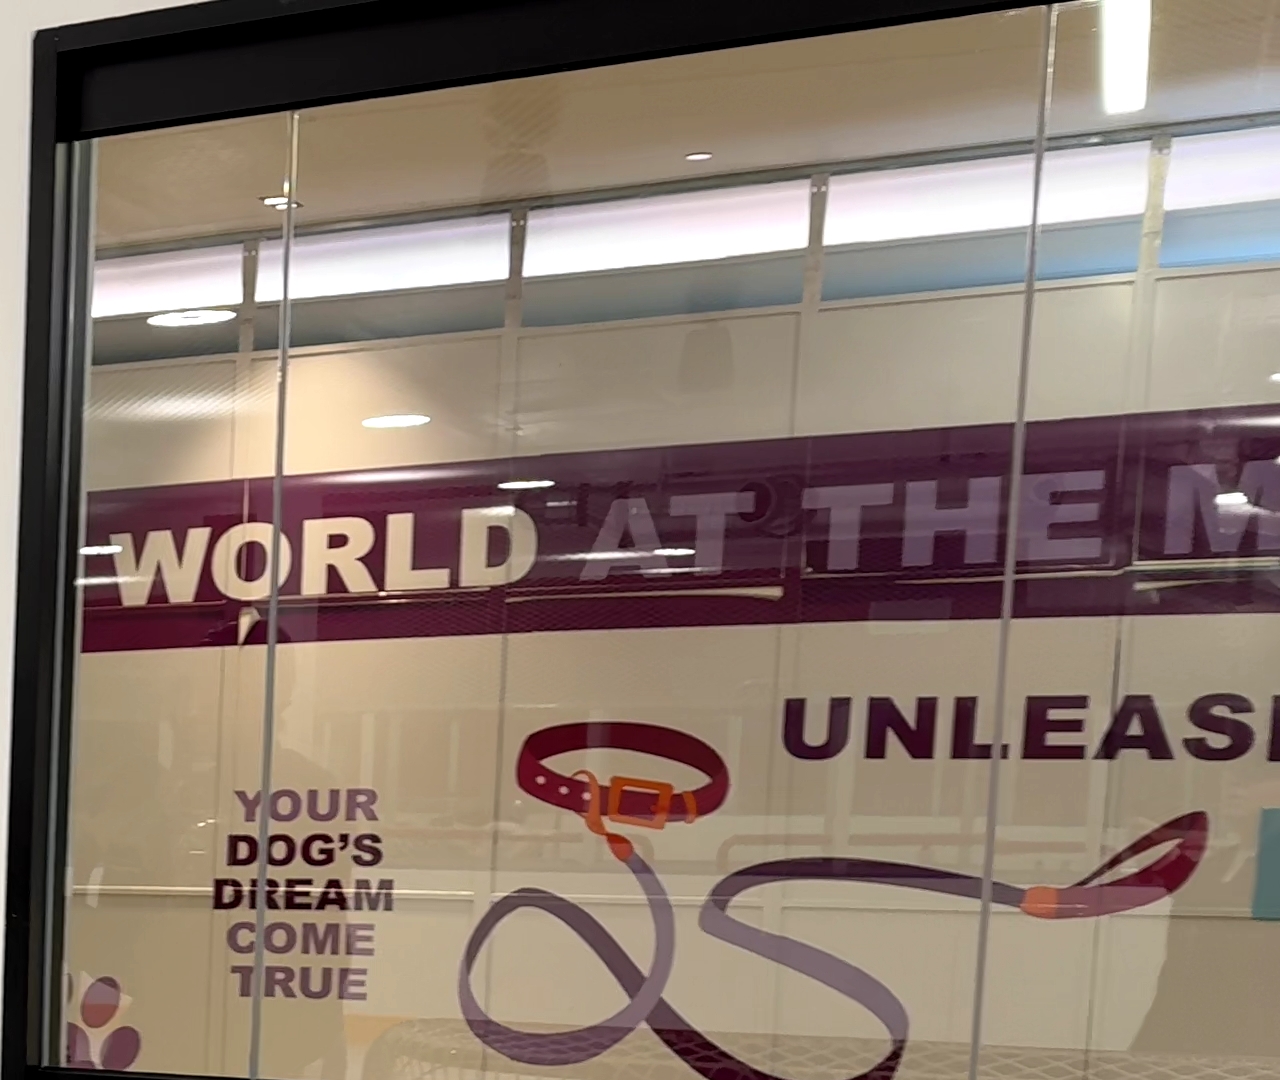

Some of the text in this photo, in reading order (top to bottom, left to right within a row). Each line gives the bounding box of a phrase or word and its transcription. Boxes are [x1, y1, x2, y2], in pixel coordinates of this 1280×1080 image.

[110, 505, 539, 607] WORLD
[580, 490, 755, 582] AT
[803, 470, 1106, 570] THE
[234, 788, 379, 822] YOUR
[226, 833, 384, 867] DOG'S
[212, 878, 394, 911] DREAM
[226, 921, 375, 956] COME
[231, 965, 368, 1001] TRUE
